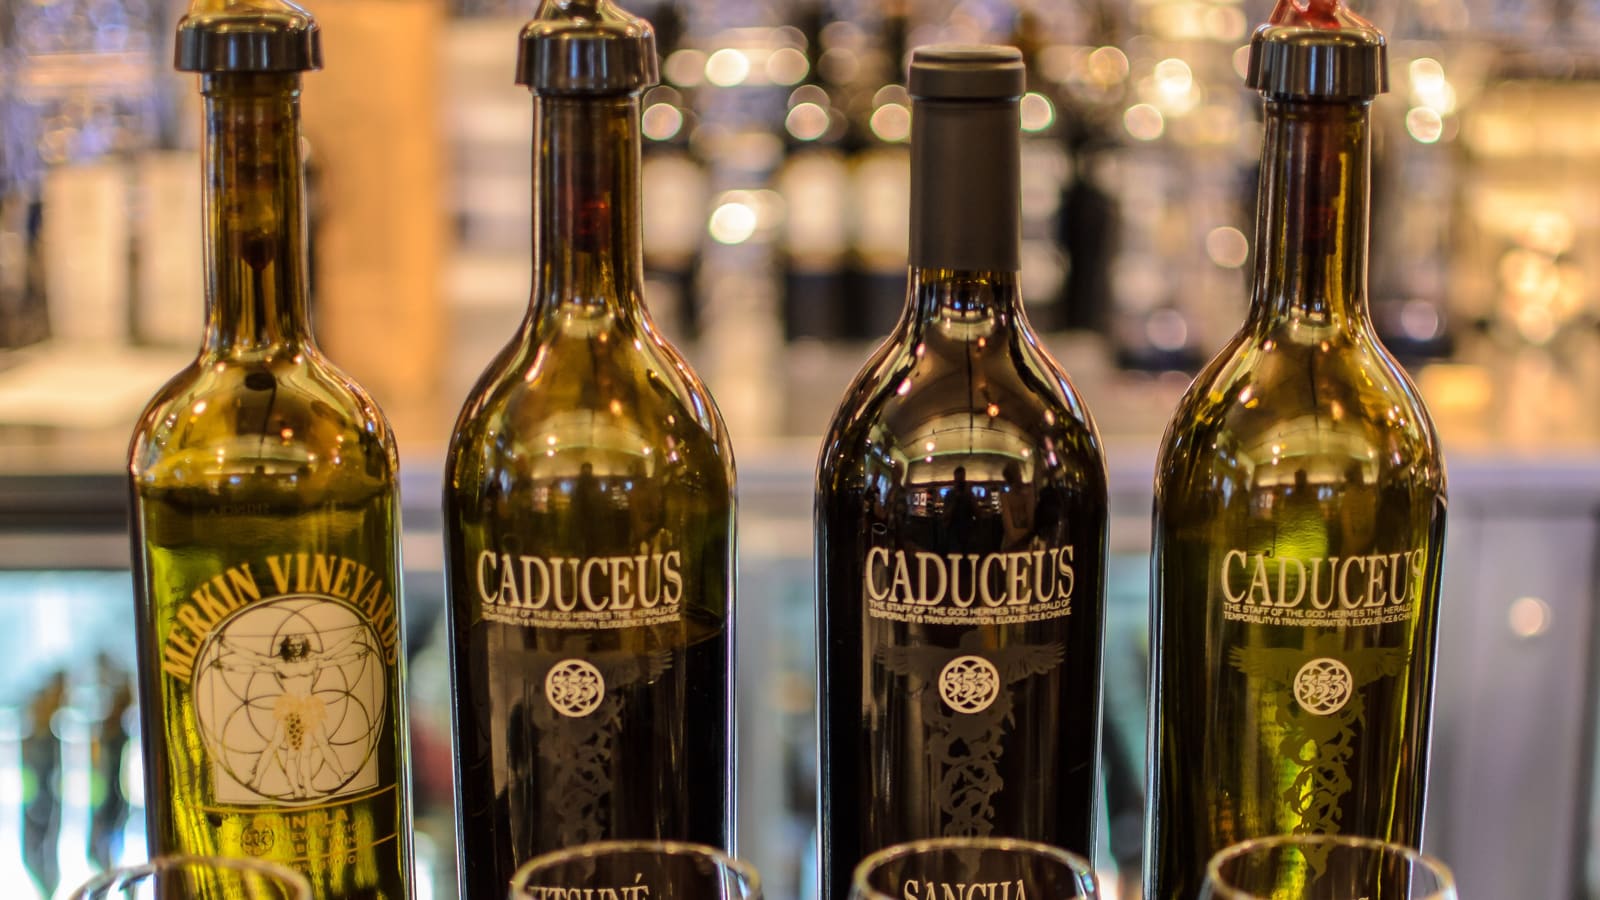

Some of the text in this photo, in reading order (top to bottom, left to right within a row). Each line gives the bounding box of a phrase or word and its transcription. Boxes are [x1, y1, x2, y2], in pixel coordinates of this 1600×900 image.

[477, 550, 683, 612] CADUCEUS
[865, 545, 1075, 607] CADUCEUS
[1221, 548, 1424, 610] CADUCEUS
[162, 553, 399, 684] MERKIN VINEYARDS
[869, 598, 1072, 617] THE STAFF OF THE GOD HERMES THE HERALD OF
[1224, 602, 1241, 612] THE
[1242, 605, 1270, 615] STAFF
[1271, 608, 1283, 616] OF
[1285, 609, 1304, 618] THE
[1305, 610, 1326, 618] GOD
[1327, 609, 1365, 618] HERMES
[1366, 607, 1382, 616] THE
[1224, 611, 1274, 624] TEMPORALITY
